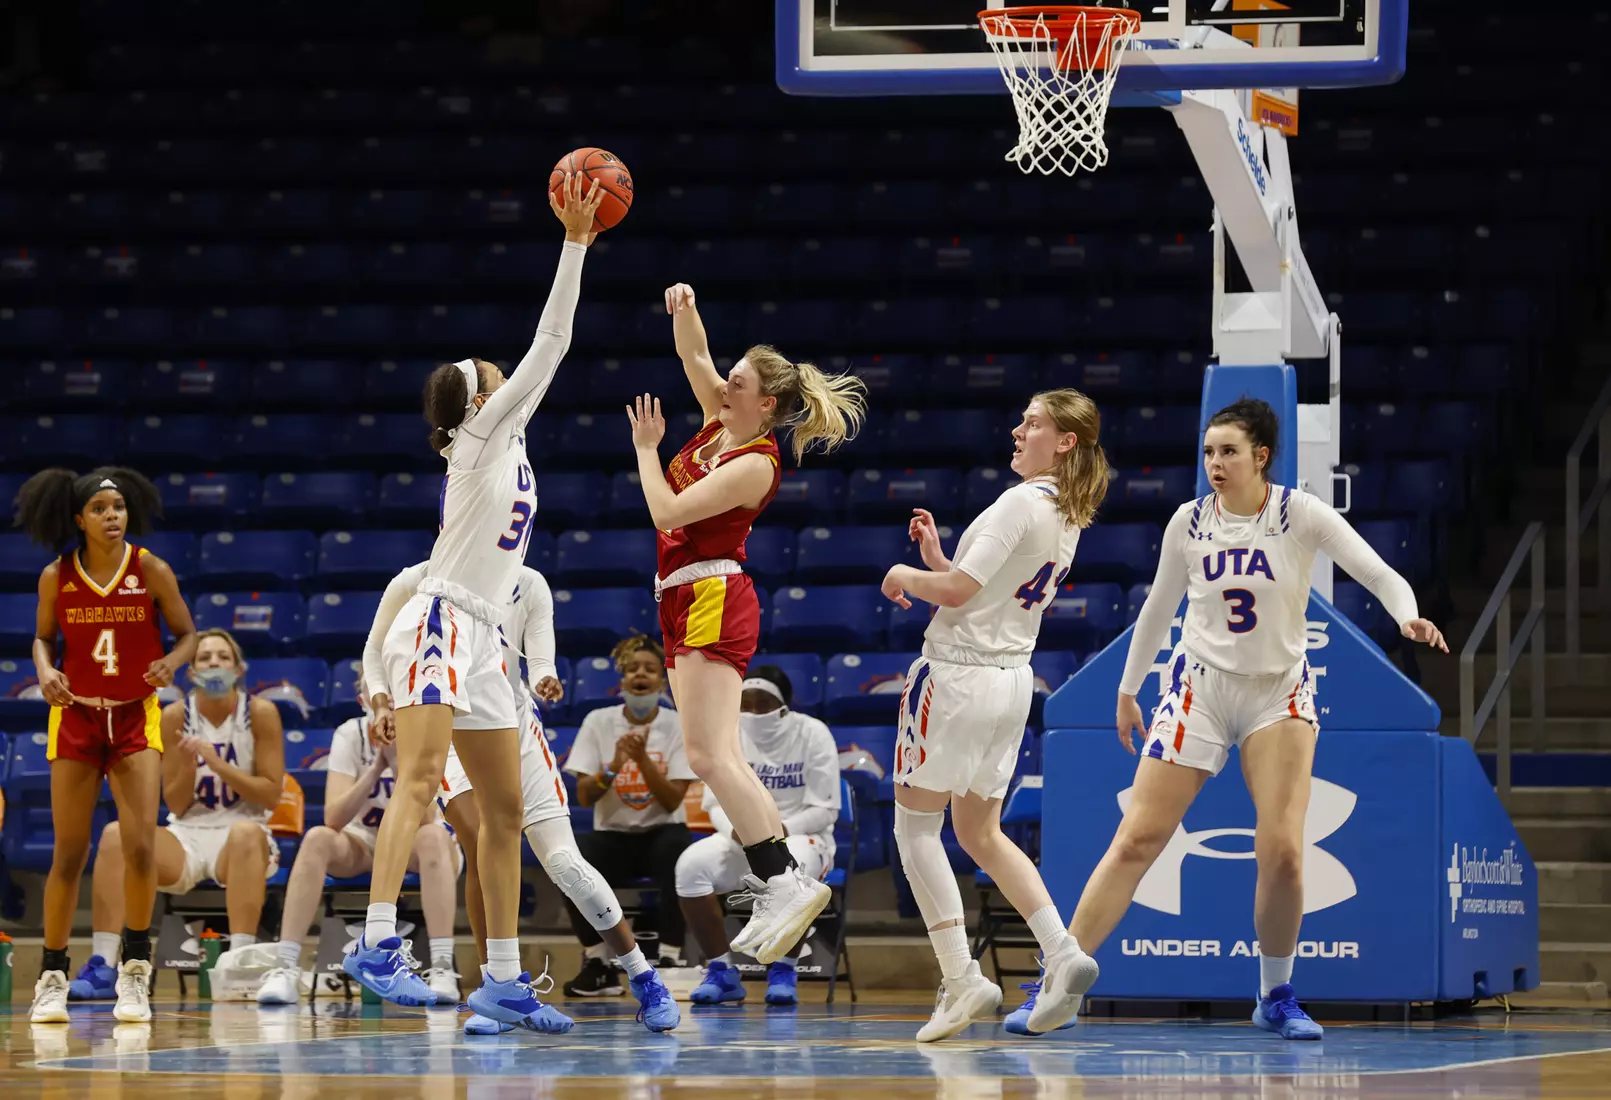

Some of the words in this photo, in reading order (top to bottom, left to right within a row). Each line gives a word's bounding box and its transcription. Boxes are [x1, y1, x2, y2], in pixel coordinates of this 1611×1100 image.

[1237, 117, 1266, 197] Schelde
[1203, 548, 1276, 582] UTA
[65, 606, 146, 624] WARHAWKS
[1222, 588, 1257, 634] 3
[91, 629, 119, 676] 4
[757, 764, 780, 775] LADY
[1121, 939, 1221, 957] UNDER
[1229, 940, 1359, 959] AROUR
[736, 963, 767, 972] NDER
[794, 965, 822, 973] OUR
